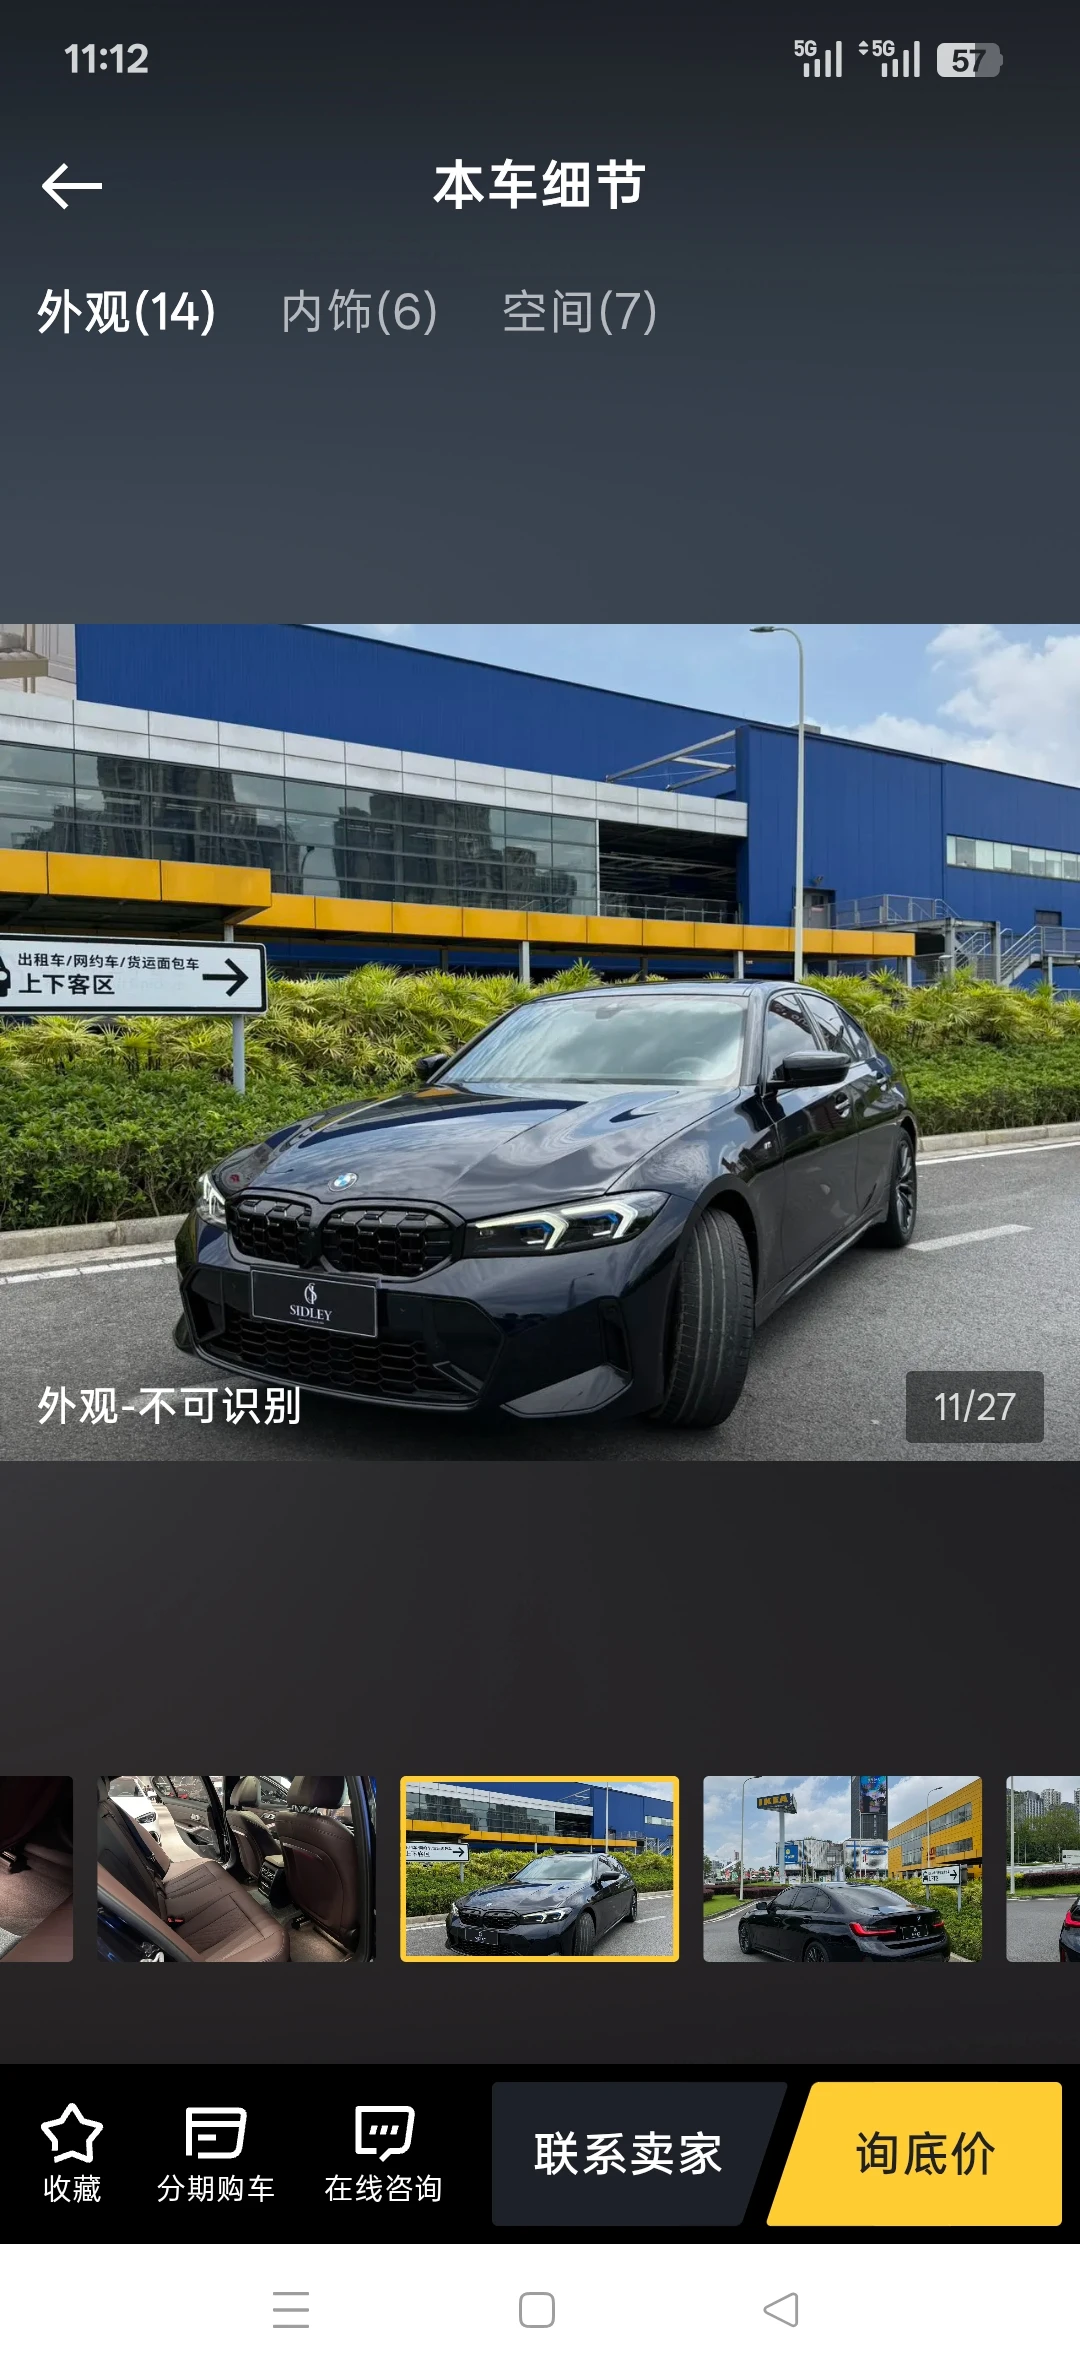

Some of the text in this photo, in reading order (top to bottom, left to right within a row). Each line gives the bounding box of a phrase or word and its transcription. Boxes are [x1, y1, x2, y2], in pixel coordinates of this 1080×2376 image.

[64, 43, 149, 74] 11:12
[794, 39, 818, 57] 5G
[872, 39, 896, 57] 5G
[952, 48, 988, 73] 57
[432, 157, 646, 210] 本车细节
[36, 288, 215, 337] 外观(14)
[282, 288, 437, 336] 内饰(6)
[502, 288, 657, 336] 空间(7)
[18, 952, 200, 970] 出租车/网约车/货运面包车
[18, 973, 115, 995] 上下客区
[289, 1304, 333, 1321] SIDLEY
[758, 1795, 789, 1806] IKEA
[534, 2130, 723, 2176] 联系卖家
[856, 2130, 996, 2176] 询底价
[43, 2174, 102, 2204] 收藏
[157, 2174, 275, 2203] 分期购车
[324, 2173, 442, 2203] 在线咨询
